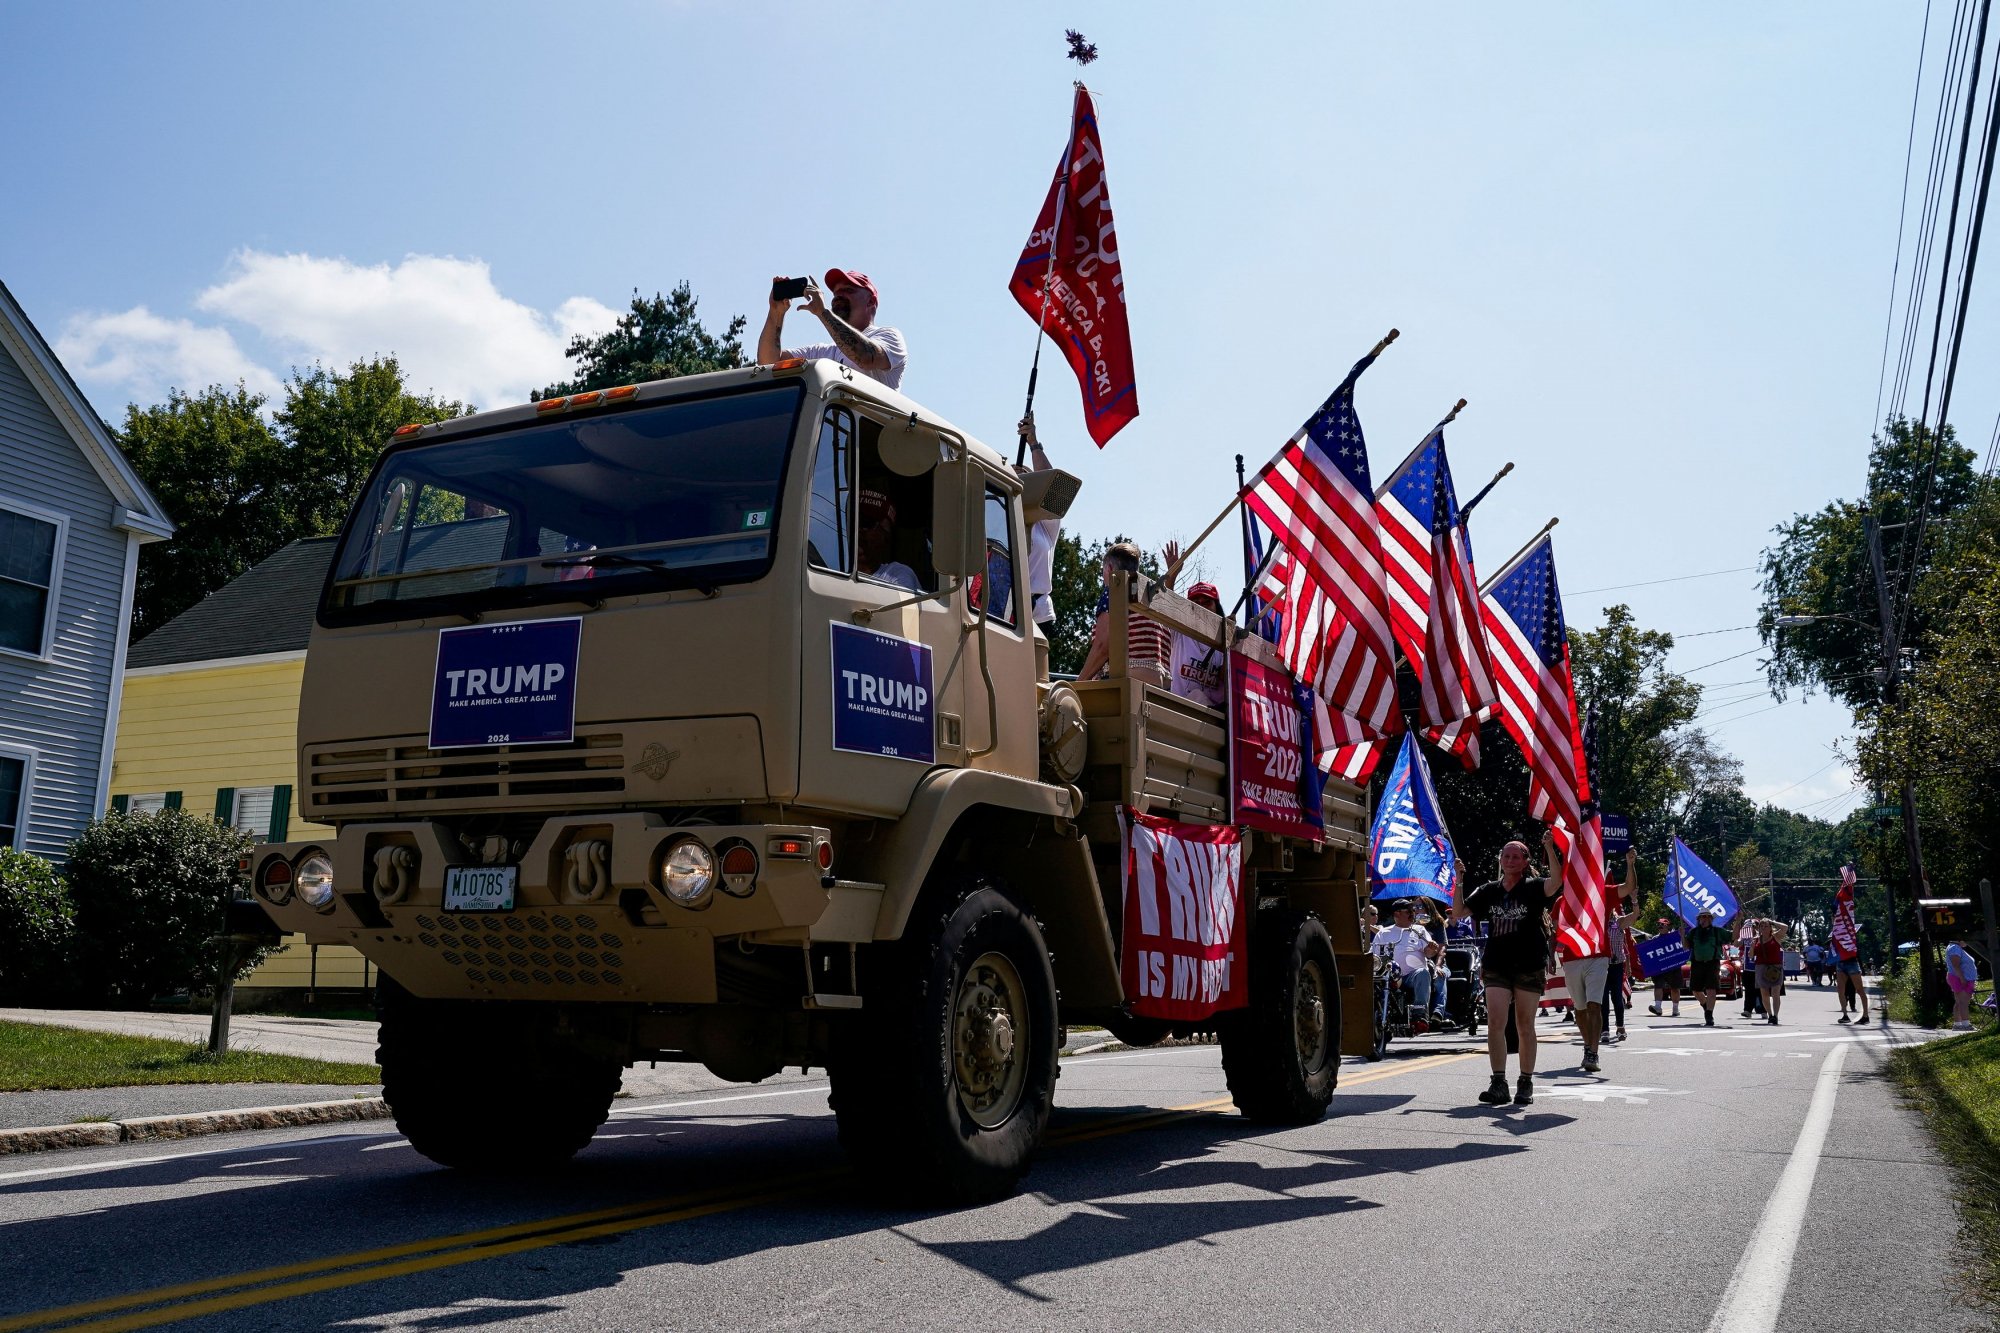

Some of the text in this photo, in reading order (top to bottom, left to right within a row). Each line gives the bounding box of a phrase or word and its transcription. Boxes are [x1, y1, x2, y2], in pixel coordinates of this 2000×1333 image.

[1041, 271, 1094, 336] MERICA
[751, 513, 758, 524] 8
[1183, 666, 1217, 686] TRUM
[1190, 657, 1221, 673] TEM
[446, 663, 565, 697] TRUMP
[842, 669, 928, 713] TRUMP
[449, 694, 557, 708] MAKE AMERICA GREAT AGAIN!
[848, 702, 925, 723] MAKE AMERICA GREAT AGAIN!
[1245, 688, 1303, 746] TRUM
[487, 734, 510, 743] 2024
[881, 745, 898, 756] 2024
[1241, 780, 1263, 803] TAKE
[452, 873, 504, 896] M1078S
[1678, 865, 1727, 917] UMP
[1646, 941, 1684, 959] TRUM
[1137, 950, 1165, 998] IS
[1171, 954, 1198, 1001] MY
